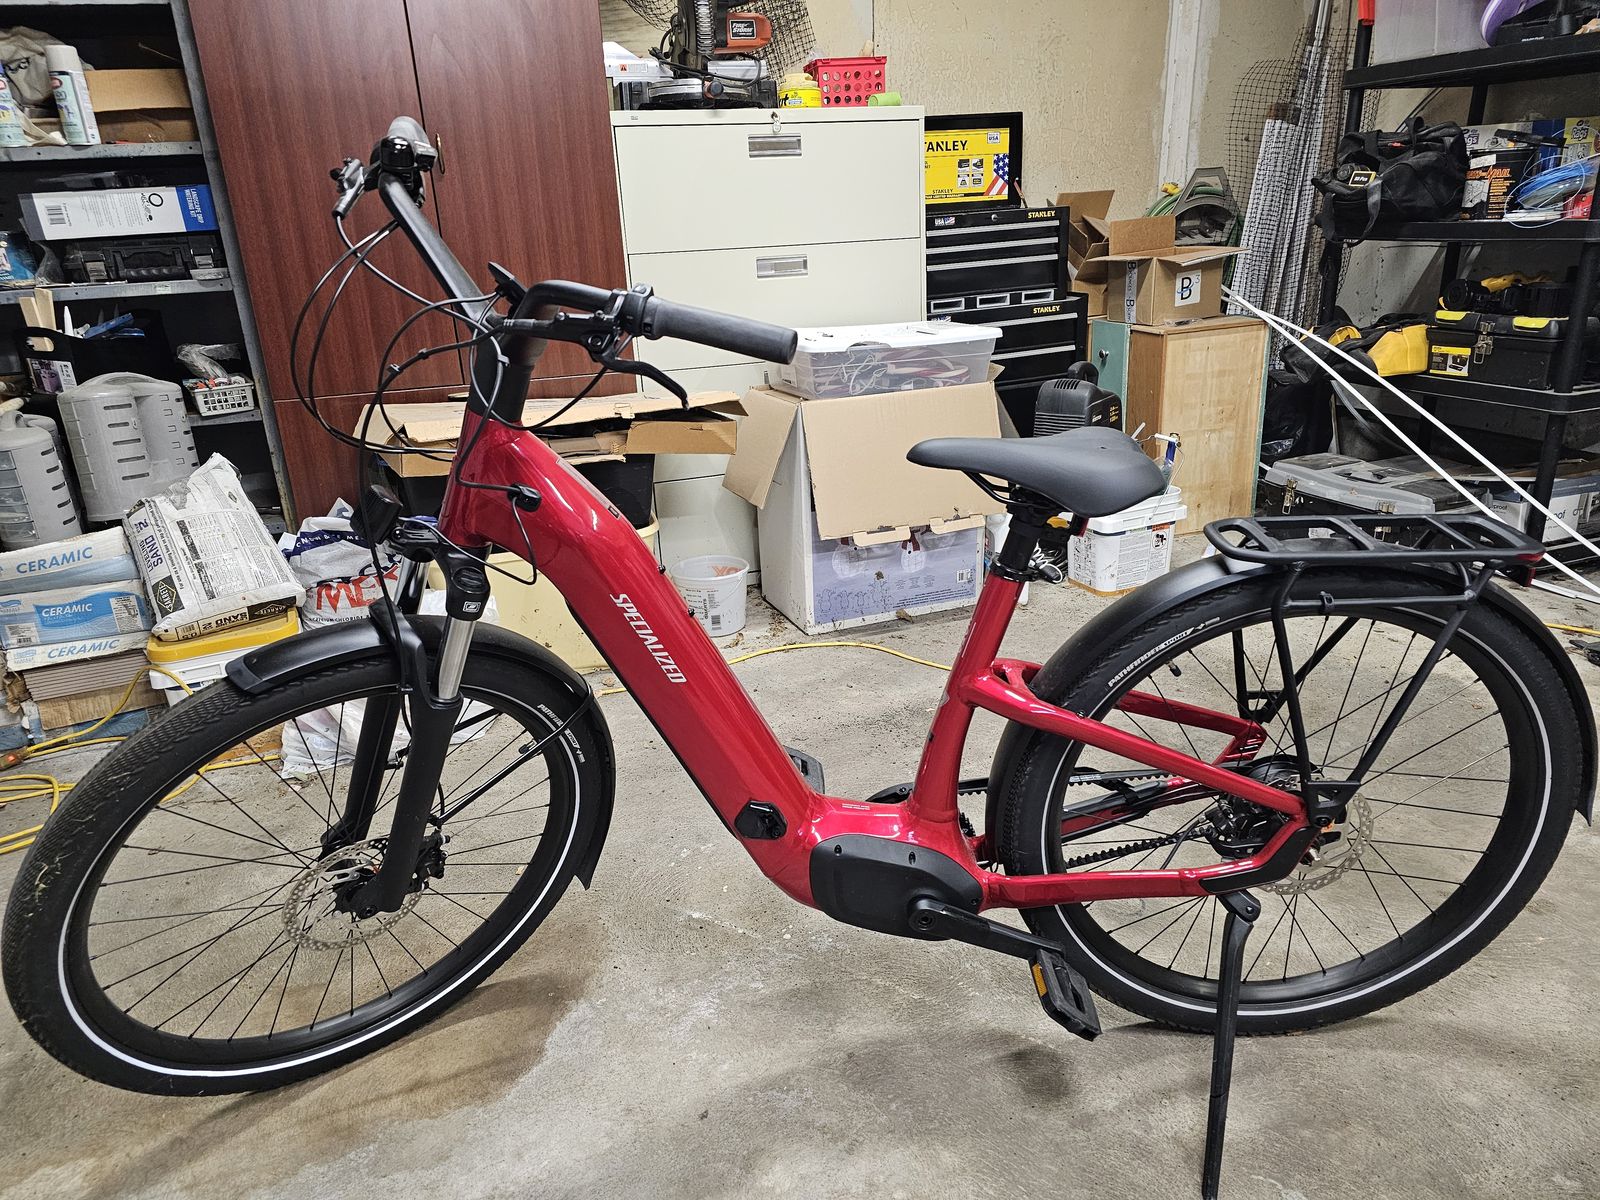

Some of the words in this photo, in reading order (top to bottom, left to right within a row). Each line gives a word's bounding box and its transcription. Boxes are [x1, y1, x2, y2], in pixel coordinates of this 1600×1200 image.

[925, 140, 968, 152] ANLEY
[934, 218, 944, 226] USA
[1027, 210, 1056, 219] STANLEY
[1033, 305, 1060, 314] STANLEY
[139, 540, 153, 572] LEVELING
[144, 534, 163, 567] SAND
[16, 547, 93, 574] CERAMIC
[159, 583, 173, 610] SAKRETE
[41, 603, 93, 618] CERAMIC
[214, 612, 248, 625] SAND
[610, 593, 688, 683] SPECIALIZED
[47, 639, 120, 659] CERAMIC
